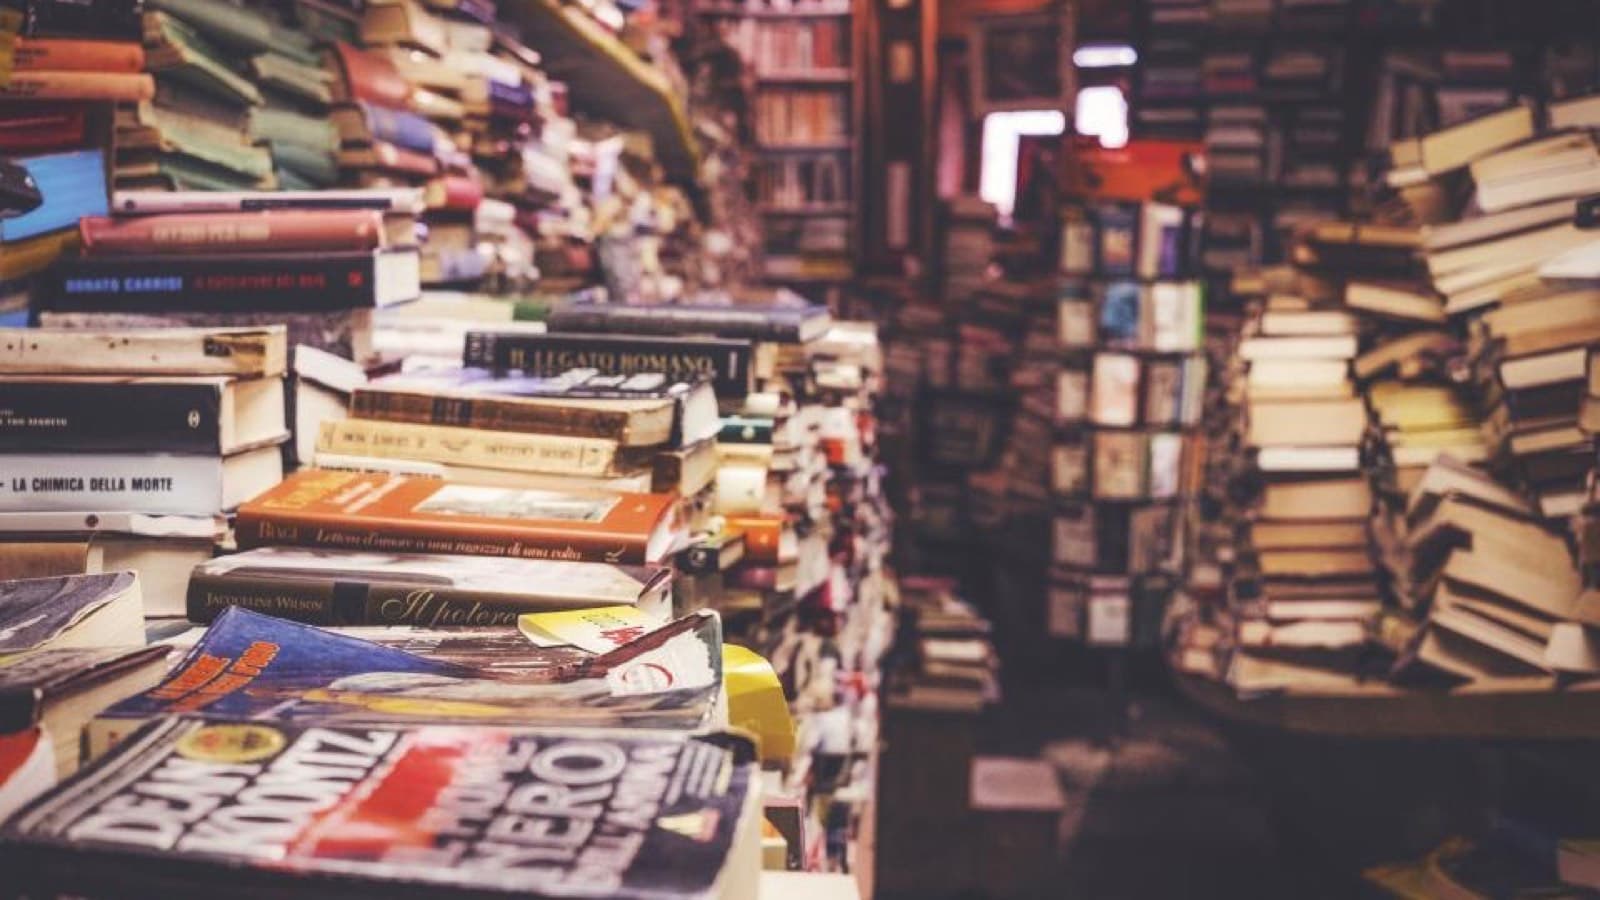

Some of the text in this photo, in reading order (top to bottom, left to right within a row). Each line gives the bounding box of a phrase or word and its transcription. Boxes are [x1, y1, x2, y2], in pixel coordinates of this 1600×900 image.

[619, 353, 713, 377] ROMANO
[12, 477, 174, 493] LA CHIMICA DELLA MORTE
[507, 540, 521, 556] di
[430, 598, 520, 628] potere
[176, 727, 404, 861] KOONTZ
[465, 741, 628, 885] NERO
